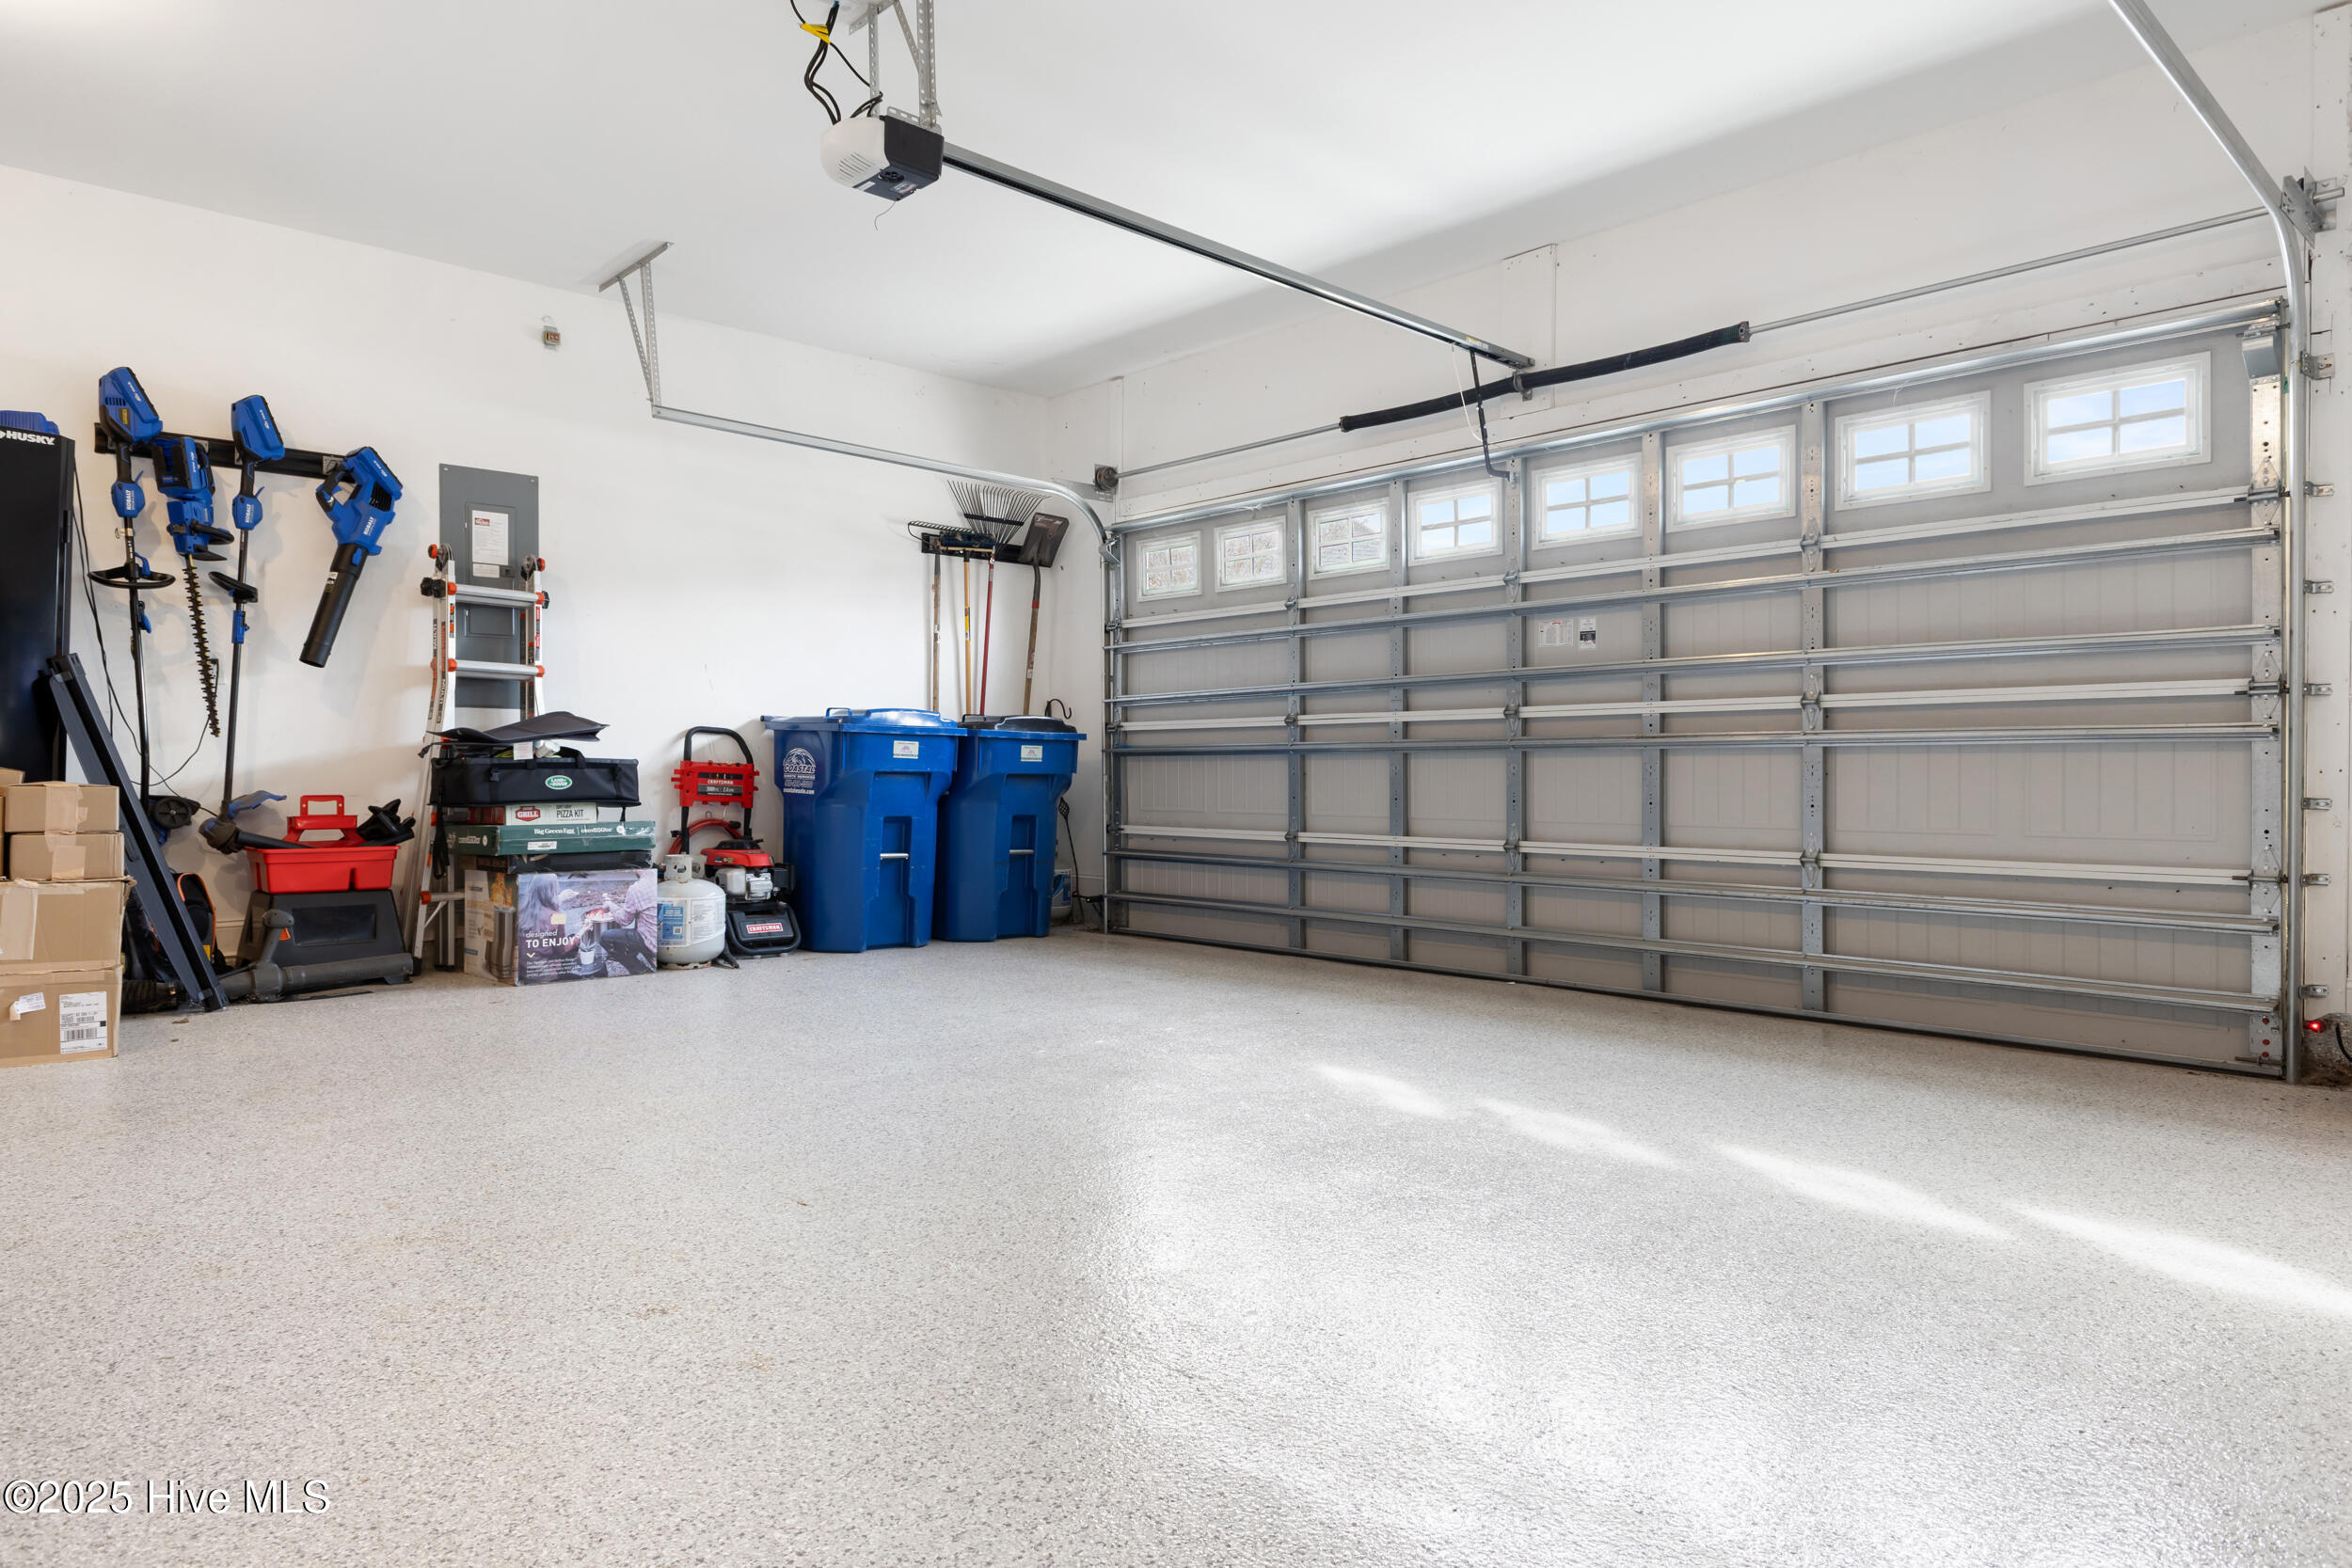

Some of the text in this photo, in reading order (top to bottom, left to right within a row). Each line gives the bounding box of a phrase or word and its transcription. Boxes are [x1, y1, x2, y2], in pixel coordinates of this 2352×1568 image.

[6, 430, 56, 445] HUSKY
[363, 516, 374, 535] KOBALT
[783, 764, 816, 773] COASTAL
[556, 809, 584, 818] PIZZA KIT
[525, 929, 558, 939] designed
[525, 936, 575, 949] TO ENJOY
